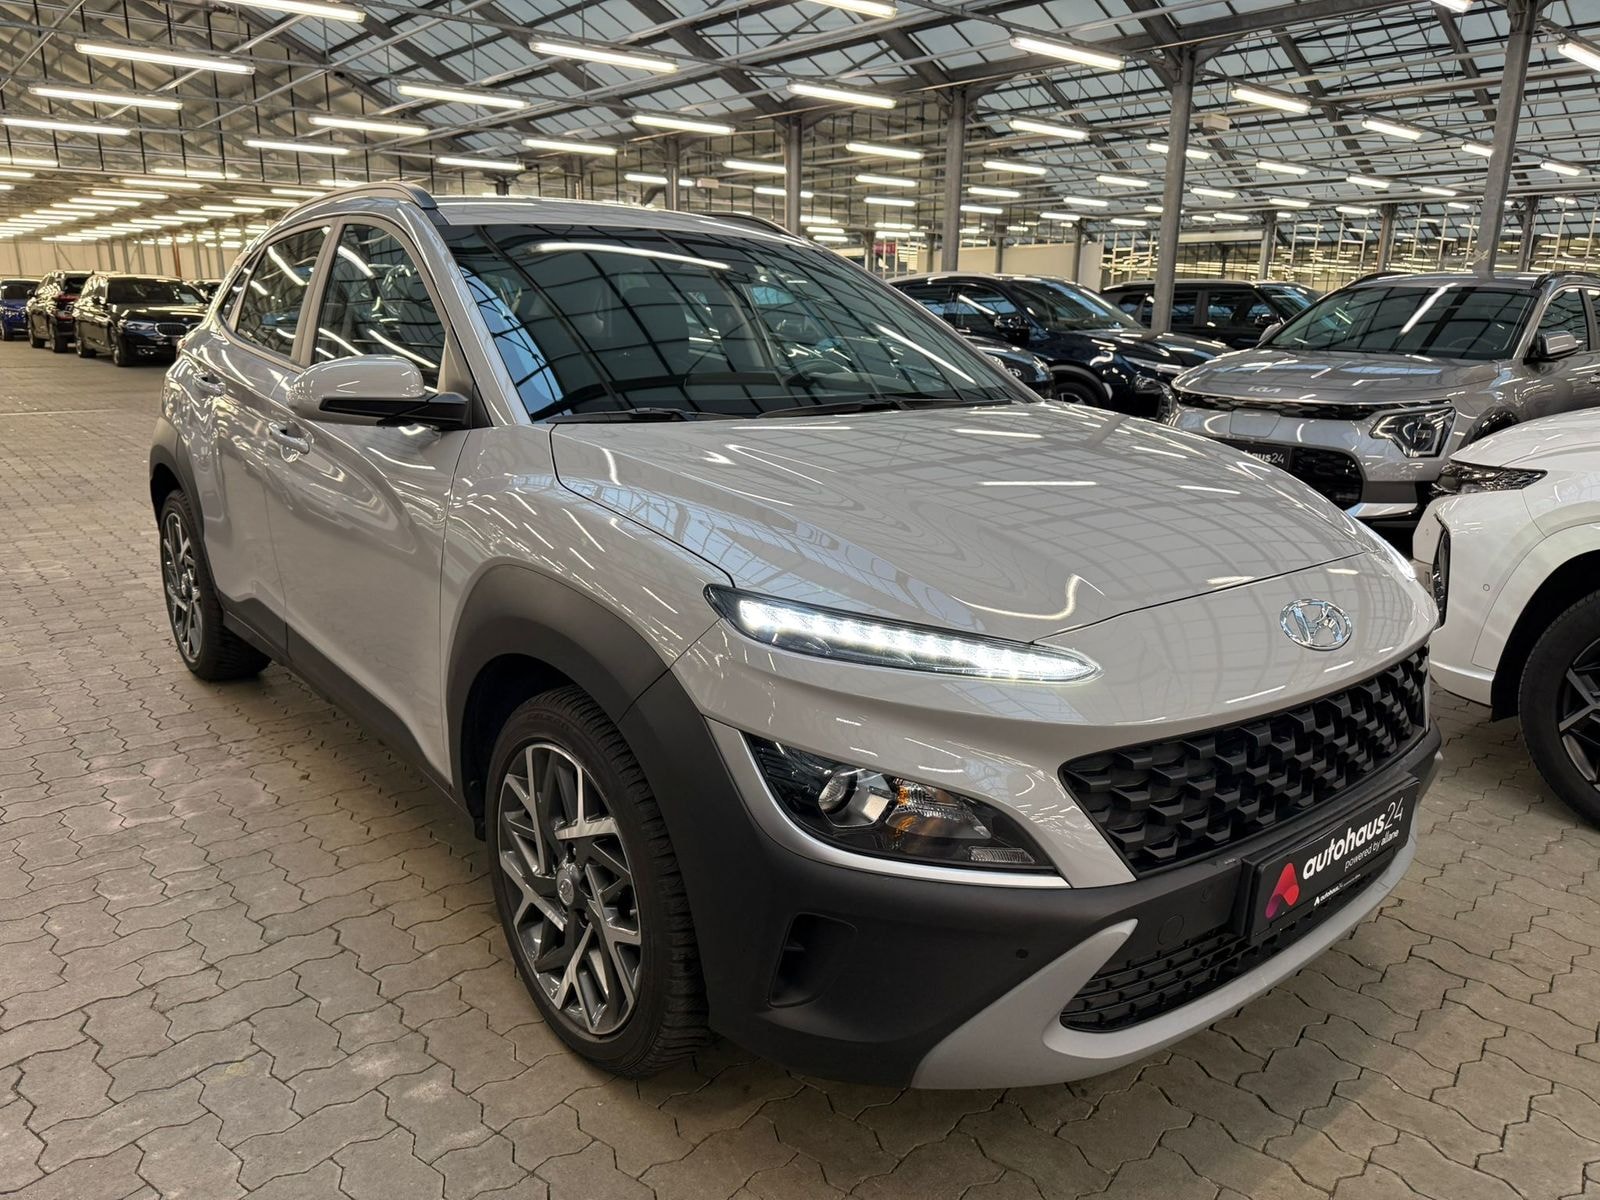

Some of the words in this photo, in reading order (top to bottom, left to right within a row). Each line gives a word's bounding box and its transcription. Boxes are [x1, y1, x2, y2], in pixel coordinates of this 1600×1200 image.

[1247, 385, 1282, 394] KIA
[1302, 797, 1403, 880] autohaus24
[1344, 842, 1373, 872] powered
[1373, 839, 1381, 852] by
